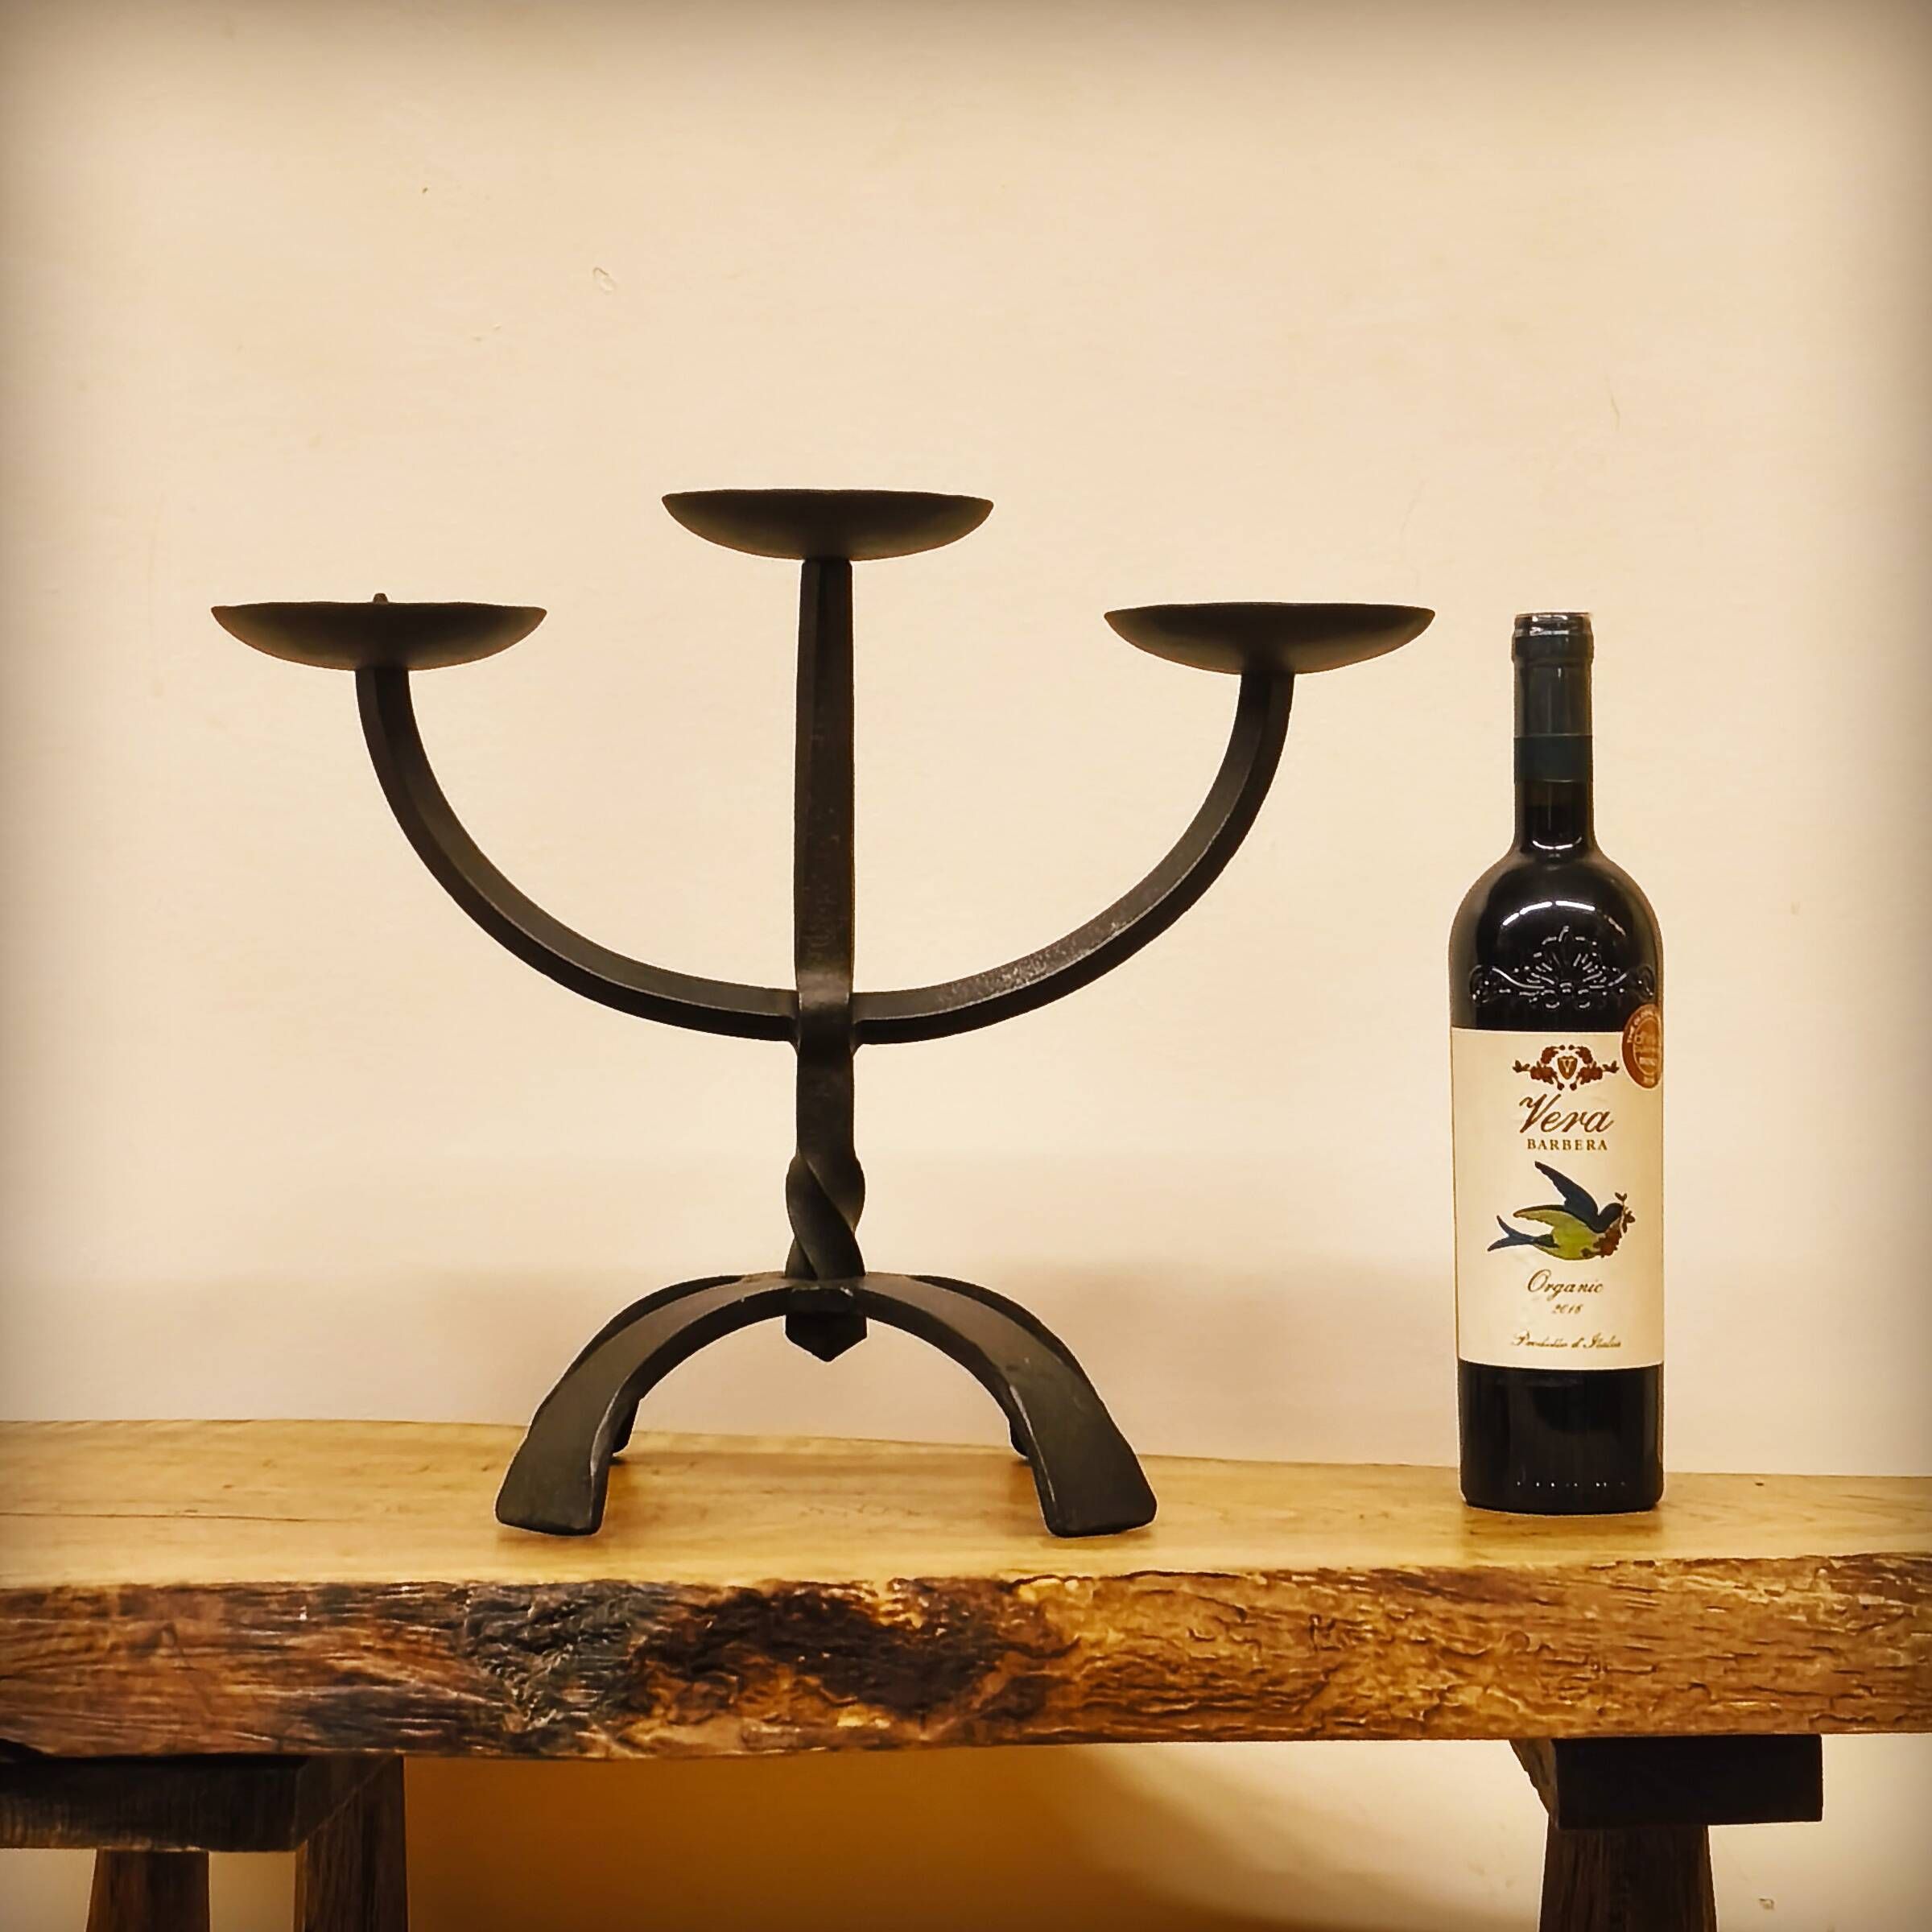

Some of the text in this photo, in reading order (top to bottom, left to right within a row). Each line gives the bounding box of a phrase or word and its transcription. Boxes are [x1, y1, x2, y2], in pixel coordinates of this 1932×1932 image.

[1519, 1093, 1614, 1133] Vera
[1527, 1139, 1608, 1150] BARBERA
[1527, 1269, 1604, 1301] Organic
